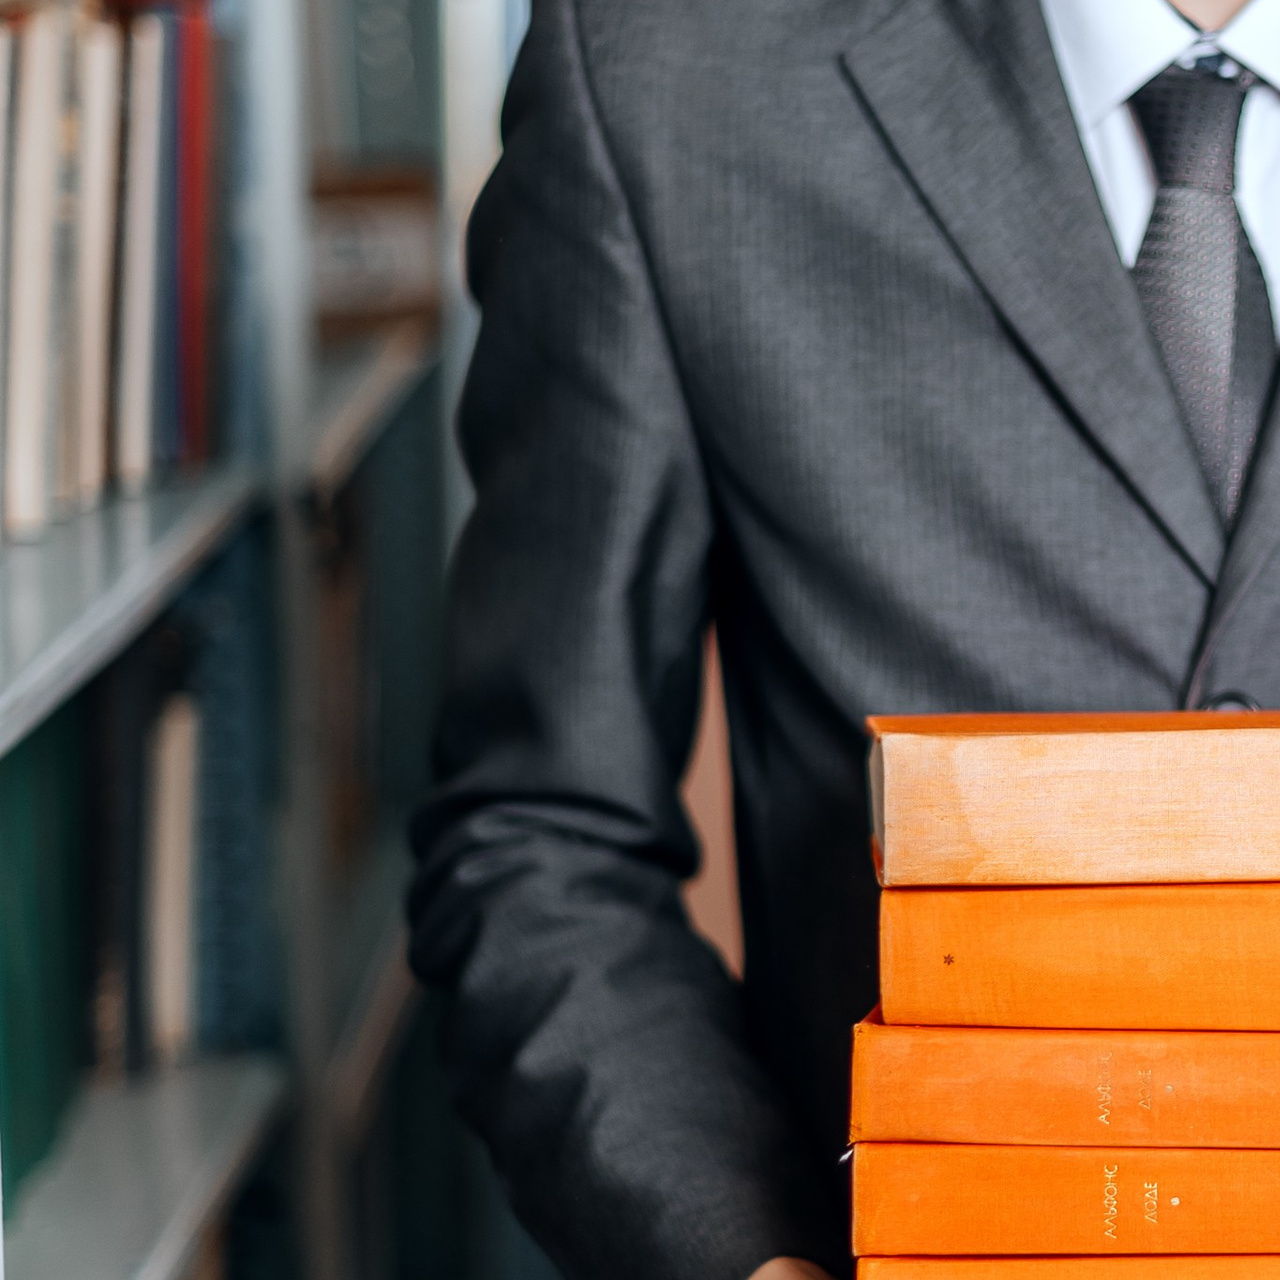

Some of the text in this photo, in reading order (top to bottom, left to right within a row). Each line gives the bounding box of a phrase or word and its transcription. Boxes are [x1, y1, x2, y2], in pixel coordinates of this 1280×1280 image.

[1097, 1050, 1113, 1125] АЛЬФС
[1103, 1163, 1118, 1240] АЛЬФОНС
[1144, 1181, 1158, 1224] ДОДЕ
